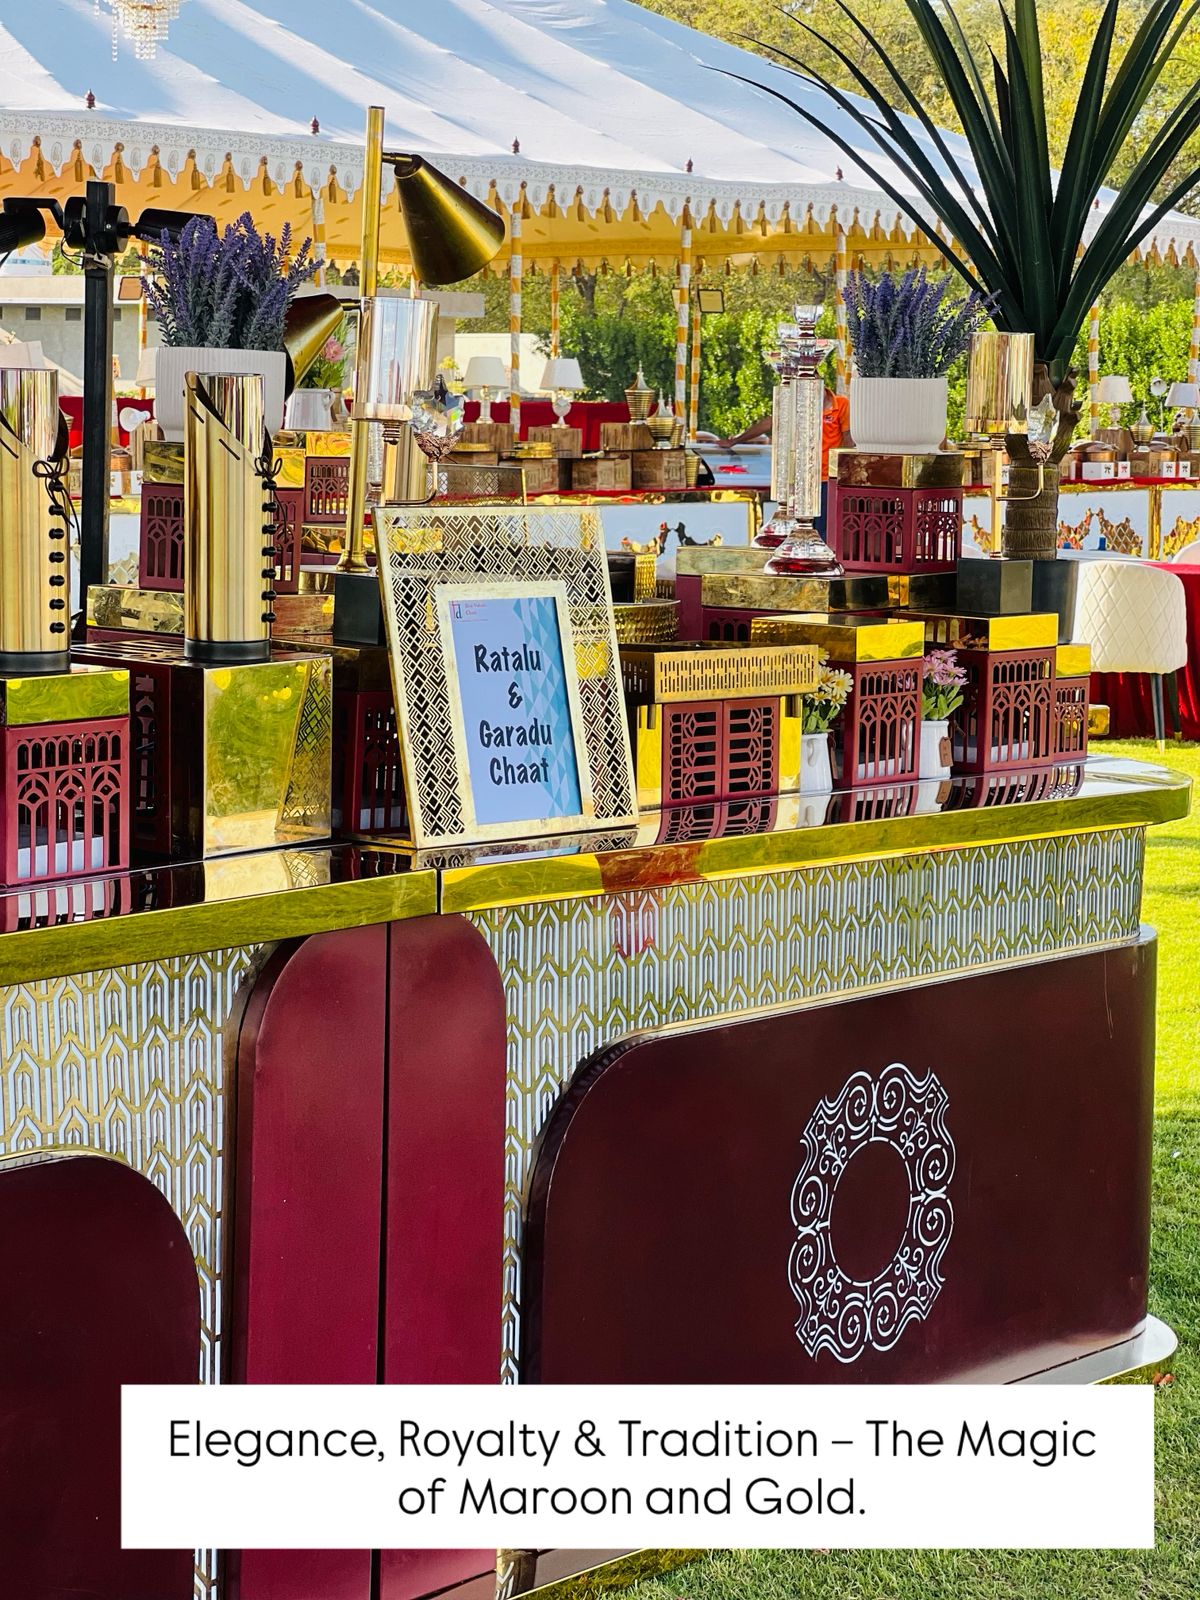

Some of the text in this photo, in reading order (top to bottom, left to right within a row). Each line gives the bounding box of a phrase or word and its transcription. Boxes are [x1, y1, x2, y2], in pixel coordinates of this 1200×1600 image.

[474, 643, 541, 673] Ratalu
[508, 681, 523, 709] &
[479, 717, 552, 748] Garadu
[489, 756, 549, 785] Chaat
